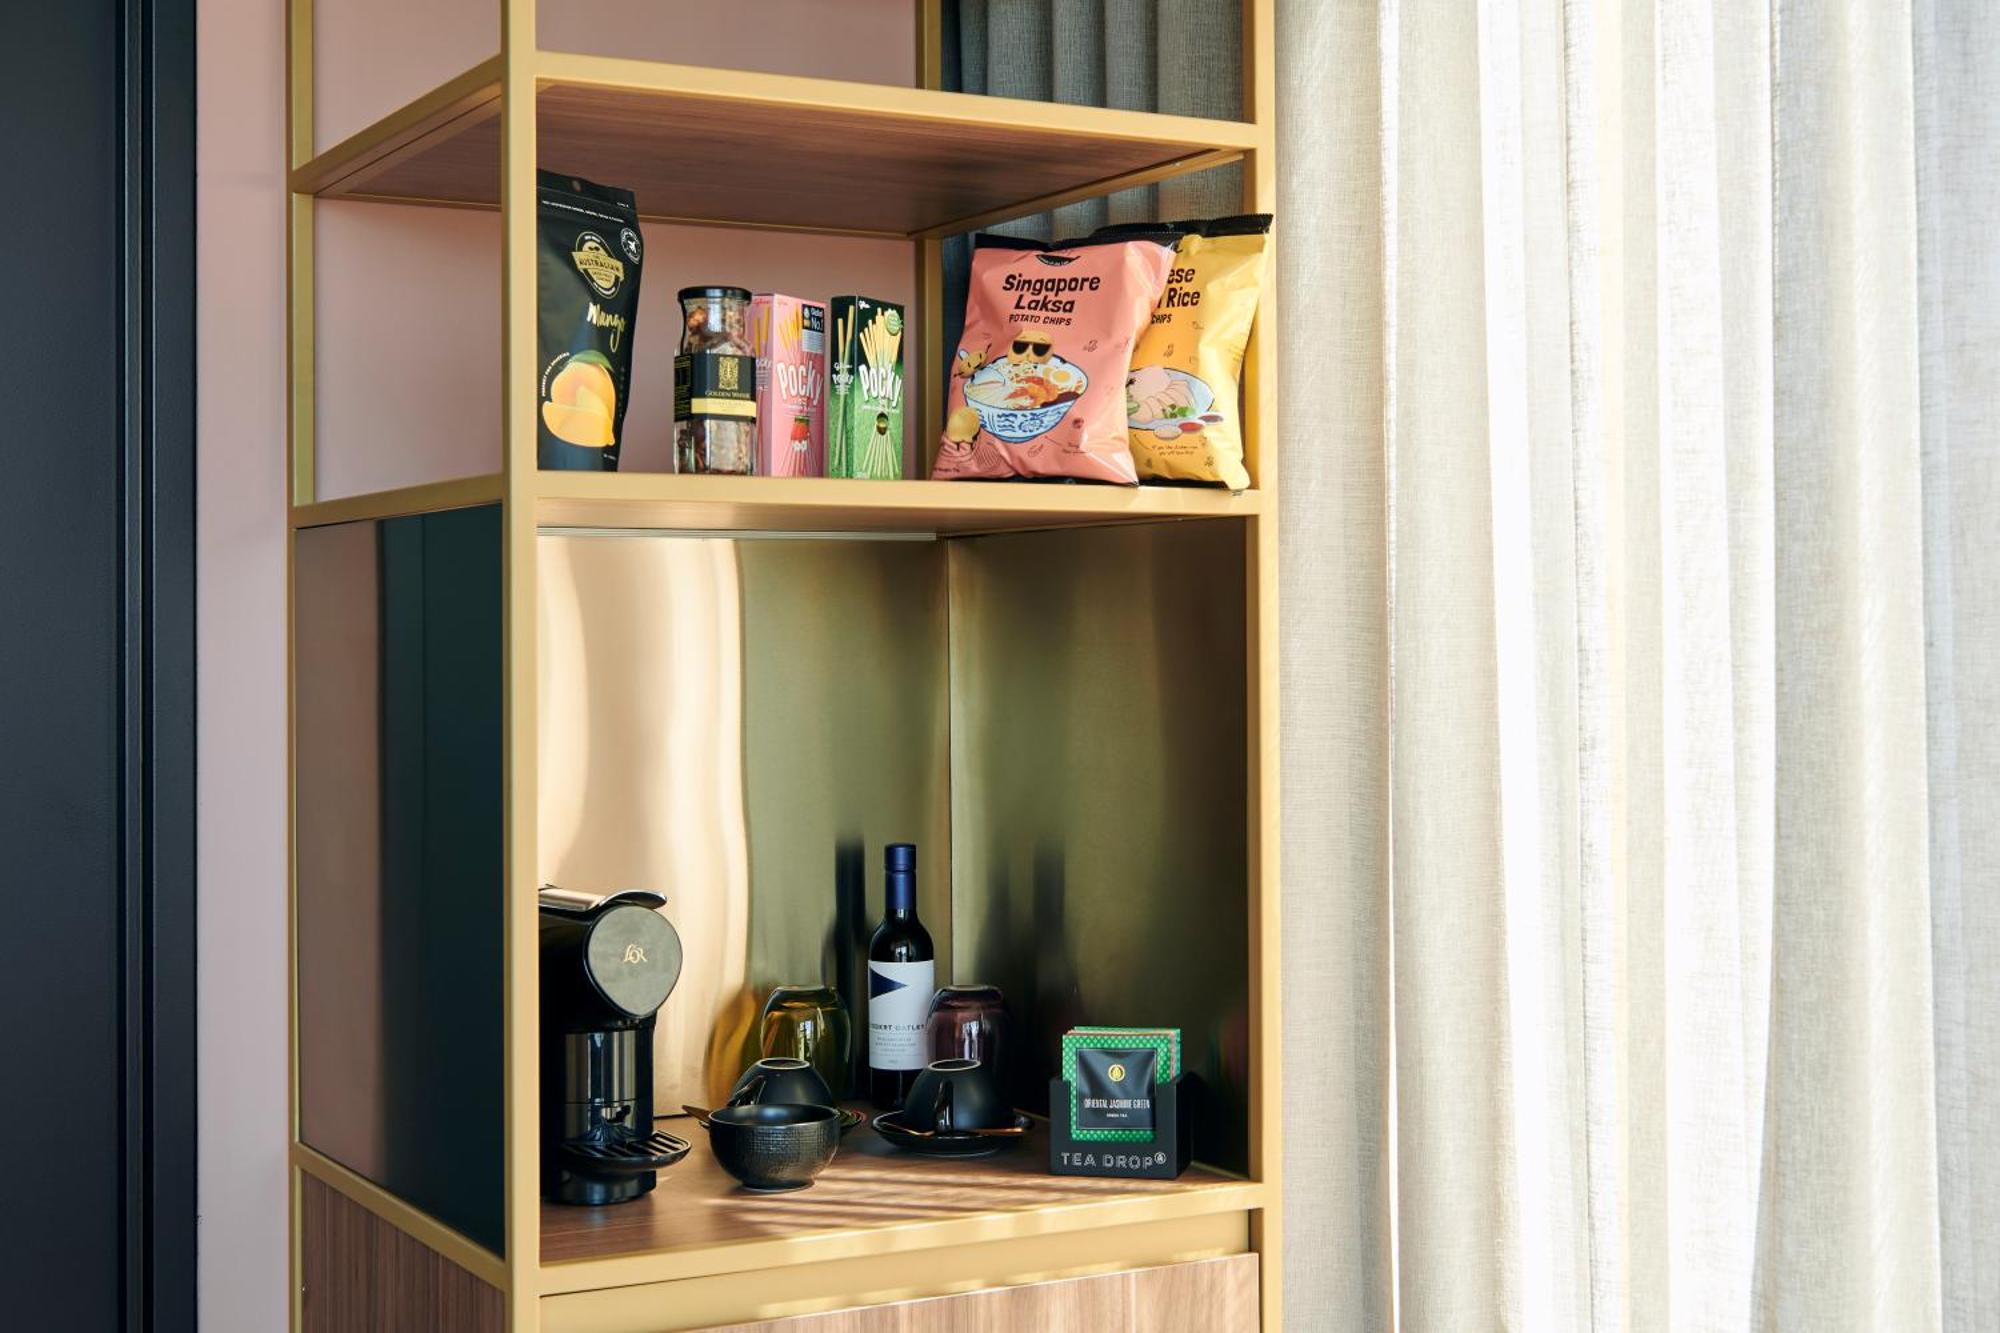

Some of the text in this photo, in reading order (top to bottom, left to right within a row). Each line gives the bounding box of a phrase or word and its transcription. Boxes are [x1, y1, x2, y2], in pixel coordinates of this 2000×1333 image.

[1002, 273, 1101, 297] Singapore
[1167, 268, 1196, 285] ese
[1014, 294, 1076, 313] Laksa
[1166, 286, 1201, 308] Rice
[586, 301, 626, 353] Mango
[1009, 314, 1073, 326] POTATO CHIPS
[1084, 1098, 1108, 1109] ORIENTAL
[1132, 1099, 1151, 1109] GREEN
[1060, 1152, 1097, 1168] TEA
